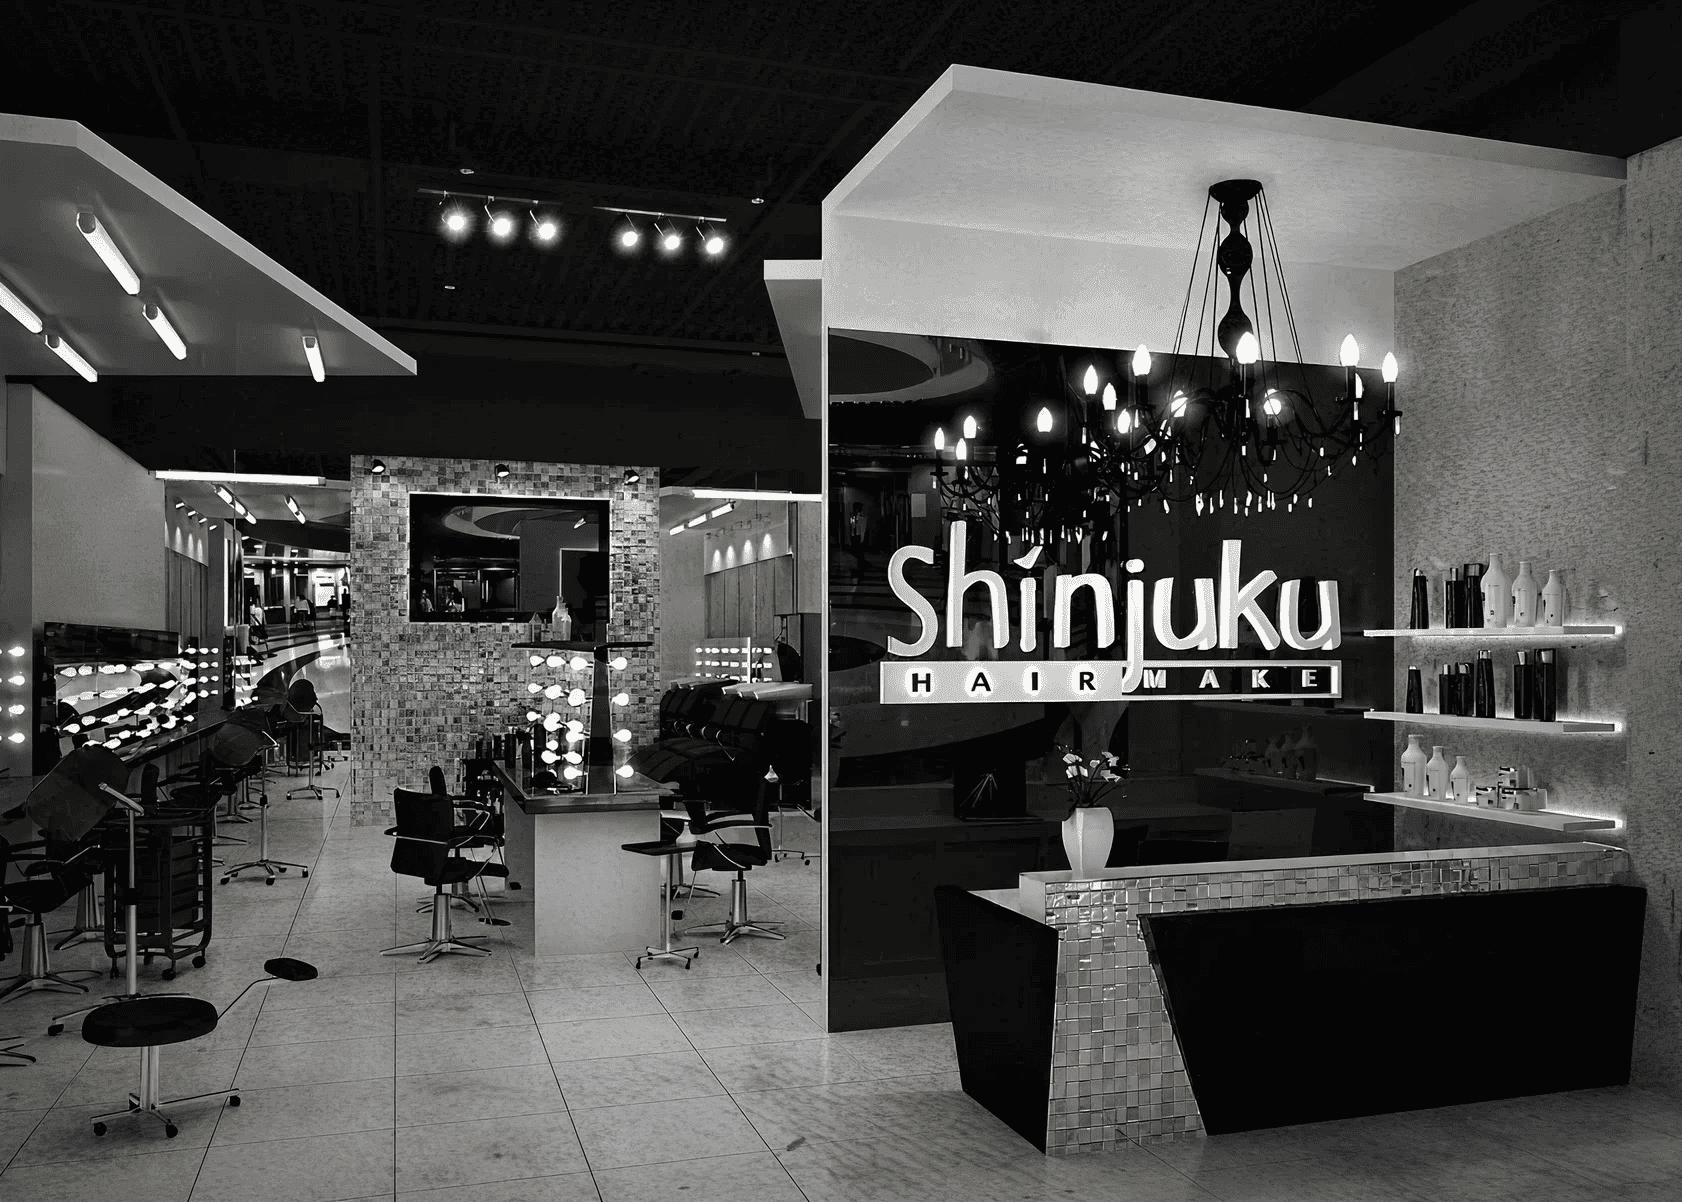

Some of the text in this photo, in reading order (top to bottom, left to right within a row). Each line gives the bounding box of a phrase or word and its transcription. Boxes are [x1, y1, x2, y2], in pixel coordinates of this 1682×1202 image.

[887, 520, 1342, 693] Shinjuku
[911, 667, 1318, 693] HAIR MAKE
